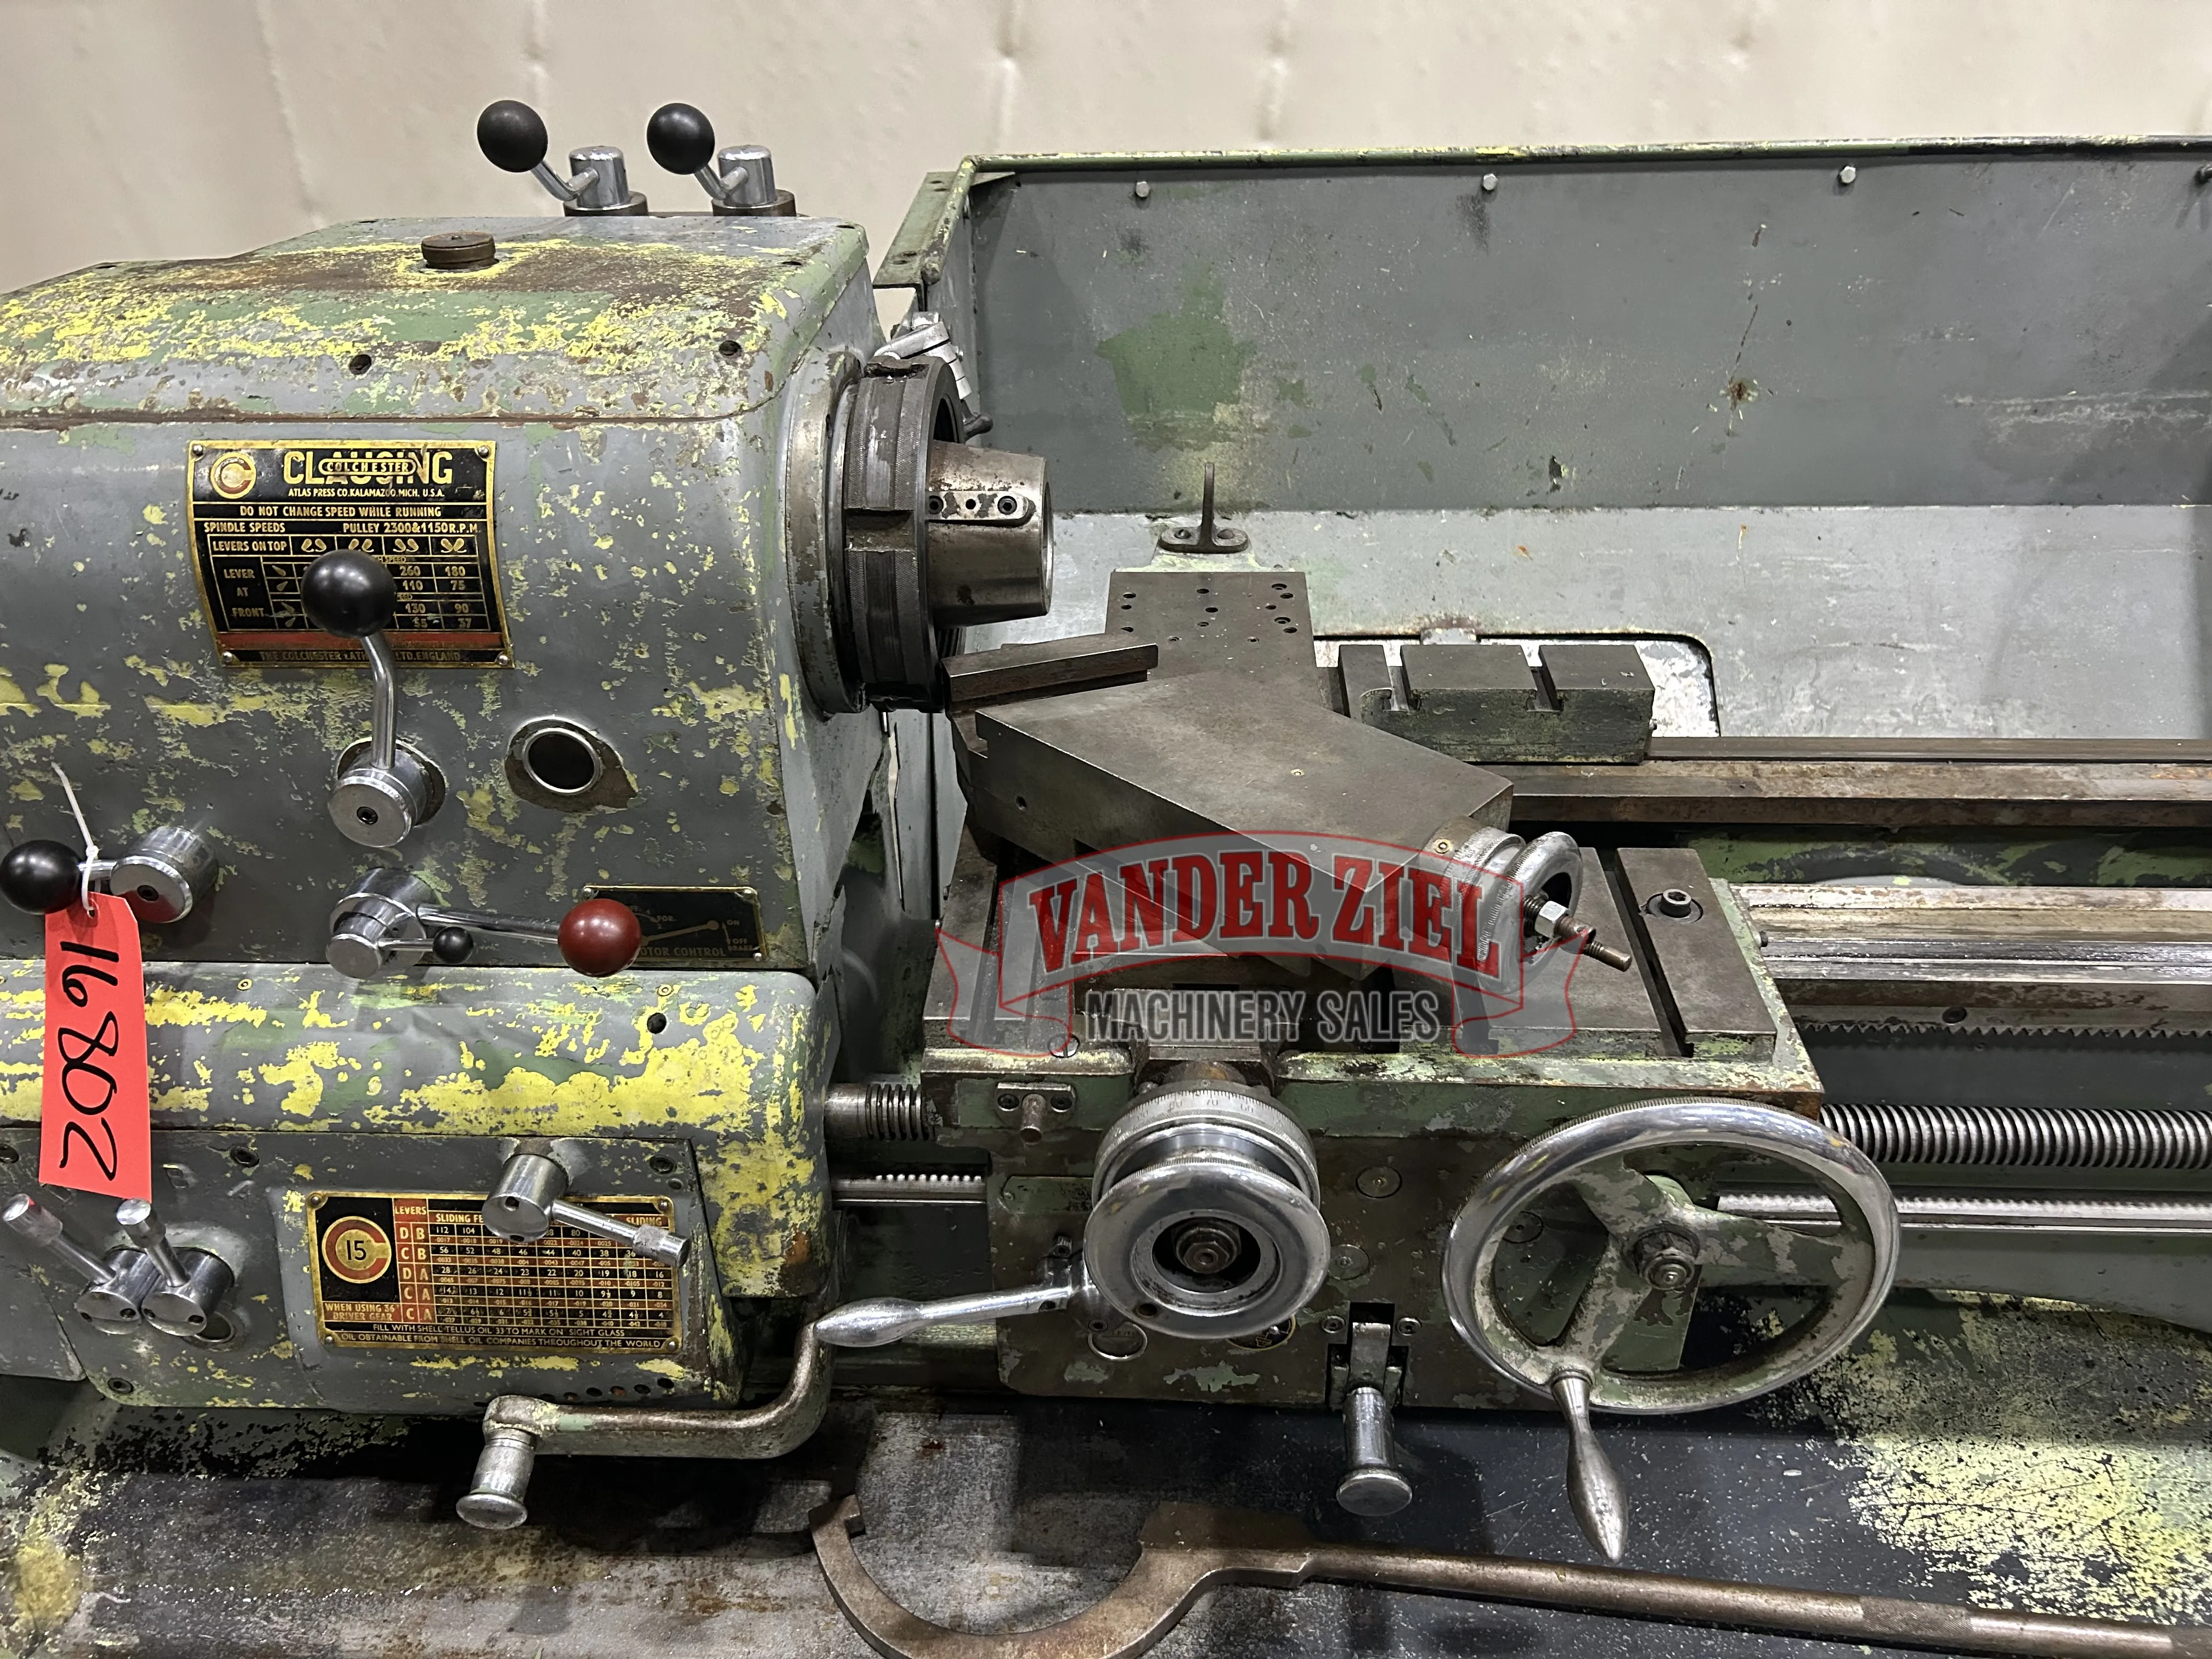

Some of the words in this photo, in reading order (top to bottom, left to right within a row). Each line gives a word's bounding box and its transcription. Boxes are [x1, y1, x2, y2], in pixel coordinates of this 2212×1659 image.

[284, 451, 453, 484] CLAUSING
[327, 462, 409, 472] COLCHESTER
[289, 488, 311, 496] ATLAS
[313, 488, 335, 496] PRESS
[423, 489, 444, 497] U.S.A.
[240, 506, 254, 516] DO
[258, 506, 278, 516] NOT
[283, 506, 323, 517] CHANGE
[325, 506, 356, 517] SPEED
[358, 506, 391, 517] WHILE
[395, 507, 442, 517] RUNNING
[204, 522, 245, 532] SPINDLE
[250, 522, 286, 533] SPEEDS
[343, 523, 379, 533] PULLEY
[212, 541, 249, 551] LEVERS
[223, 569, 255, 579] LEVER
[399, 566, 421, 576] 260
[445, 566, 466, 576] 180
[402, 580, 423, 590] 110
[450, 580, 465, 590] 75
[236, 587, 249, 597] AT
[232, 608, 264, 617] FRONT
[405, 603, 426, 613] 130
[454, 603, 469, 613] 90
[458, 618, 472, 629] 37
[259, 651, 277, 660] THE
[674, 947, 726, 957] CONTROL
[58, 941, 119, 1181] 20891
[394, 1206, 427, 1215] LEVERS
[436, 1213, 471, 1223] SLIDING
[626, 1217, 662, 1226] SLIDING
[399, 1227, 409, 1239] D
[416, 1227, 425, 1240] B
[347, 1239, 367, 1261] 15
[401, 1247, 409, 1260] C
[417, 1248, 426, 1260] B
[403, 1267, 411, 1279] D
[420, 1268, 428, 1280] A
[404, 1287, 413, 1299] C
[422, 1288, 431, 1300] A
[325, 1303, 352, 1311] WHEN
[355, 1304, 382, 1312] USING
[333, 1312, 365, 1321] DRIVER
[369, 1313, 393, 1321] GEAR
[406, 1308, 414, 1320] C
[424, 1308, 432, 1321] A
[358, 1334, 412, 1342] OBTAINABLE
